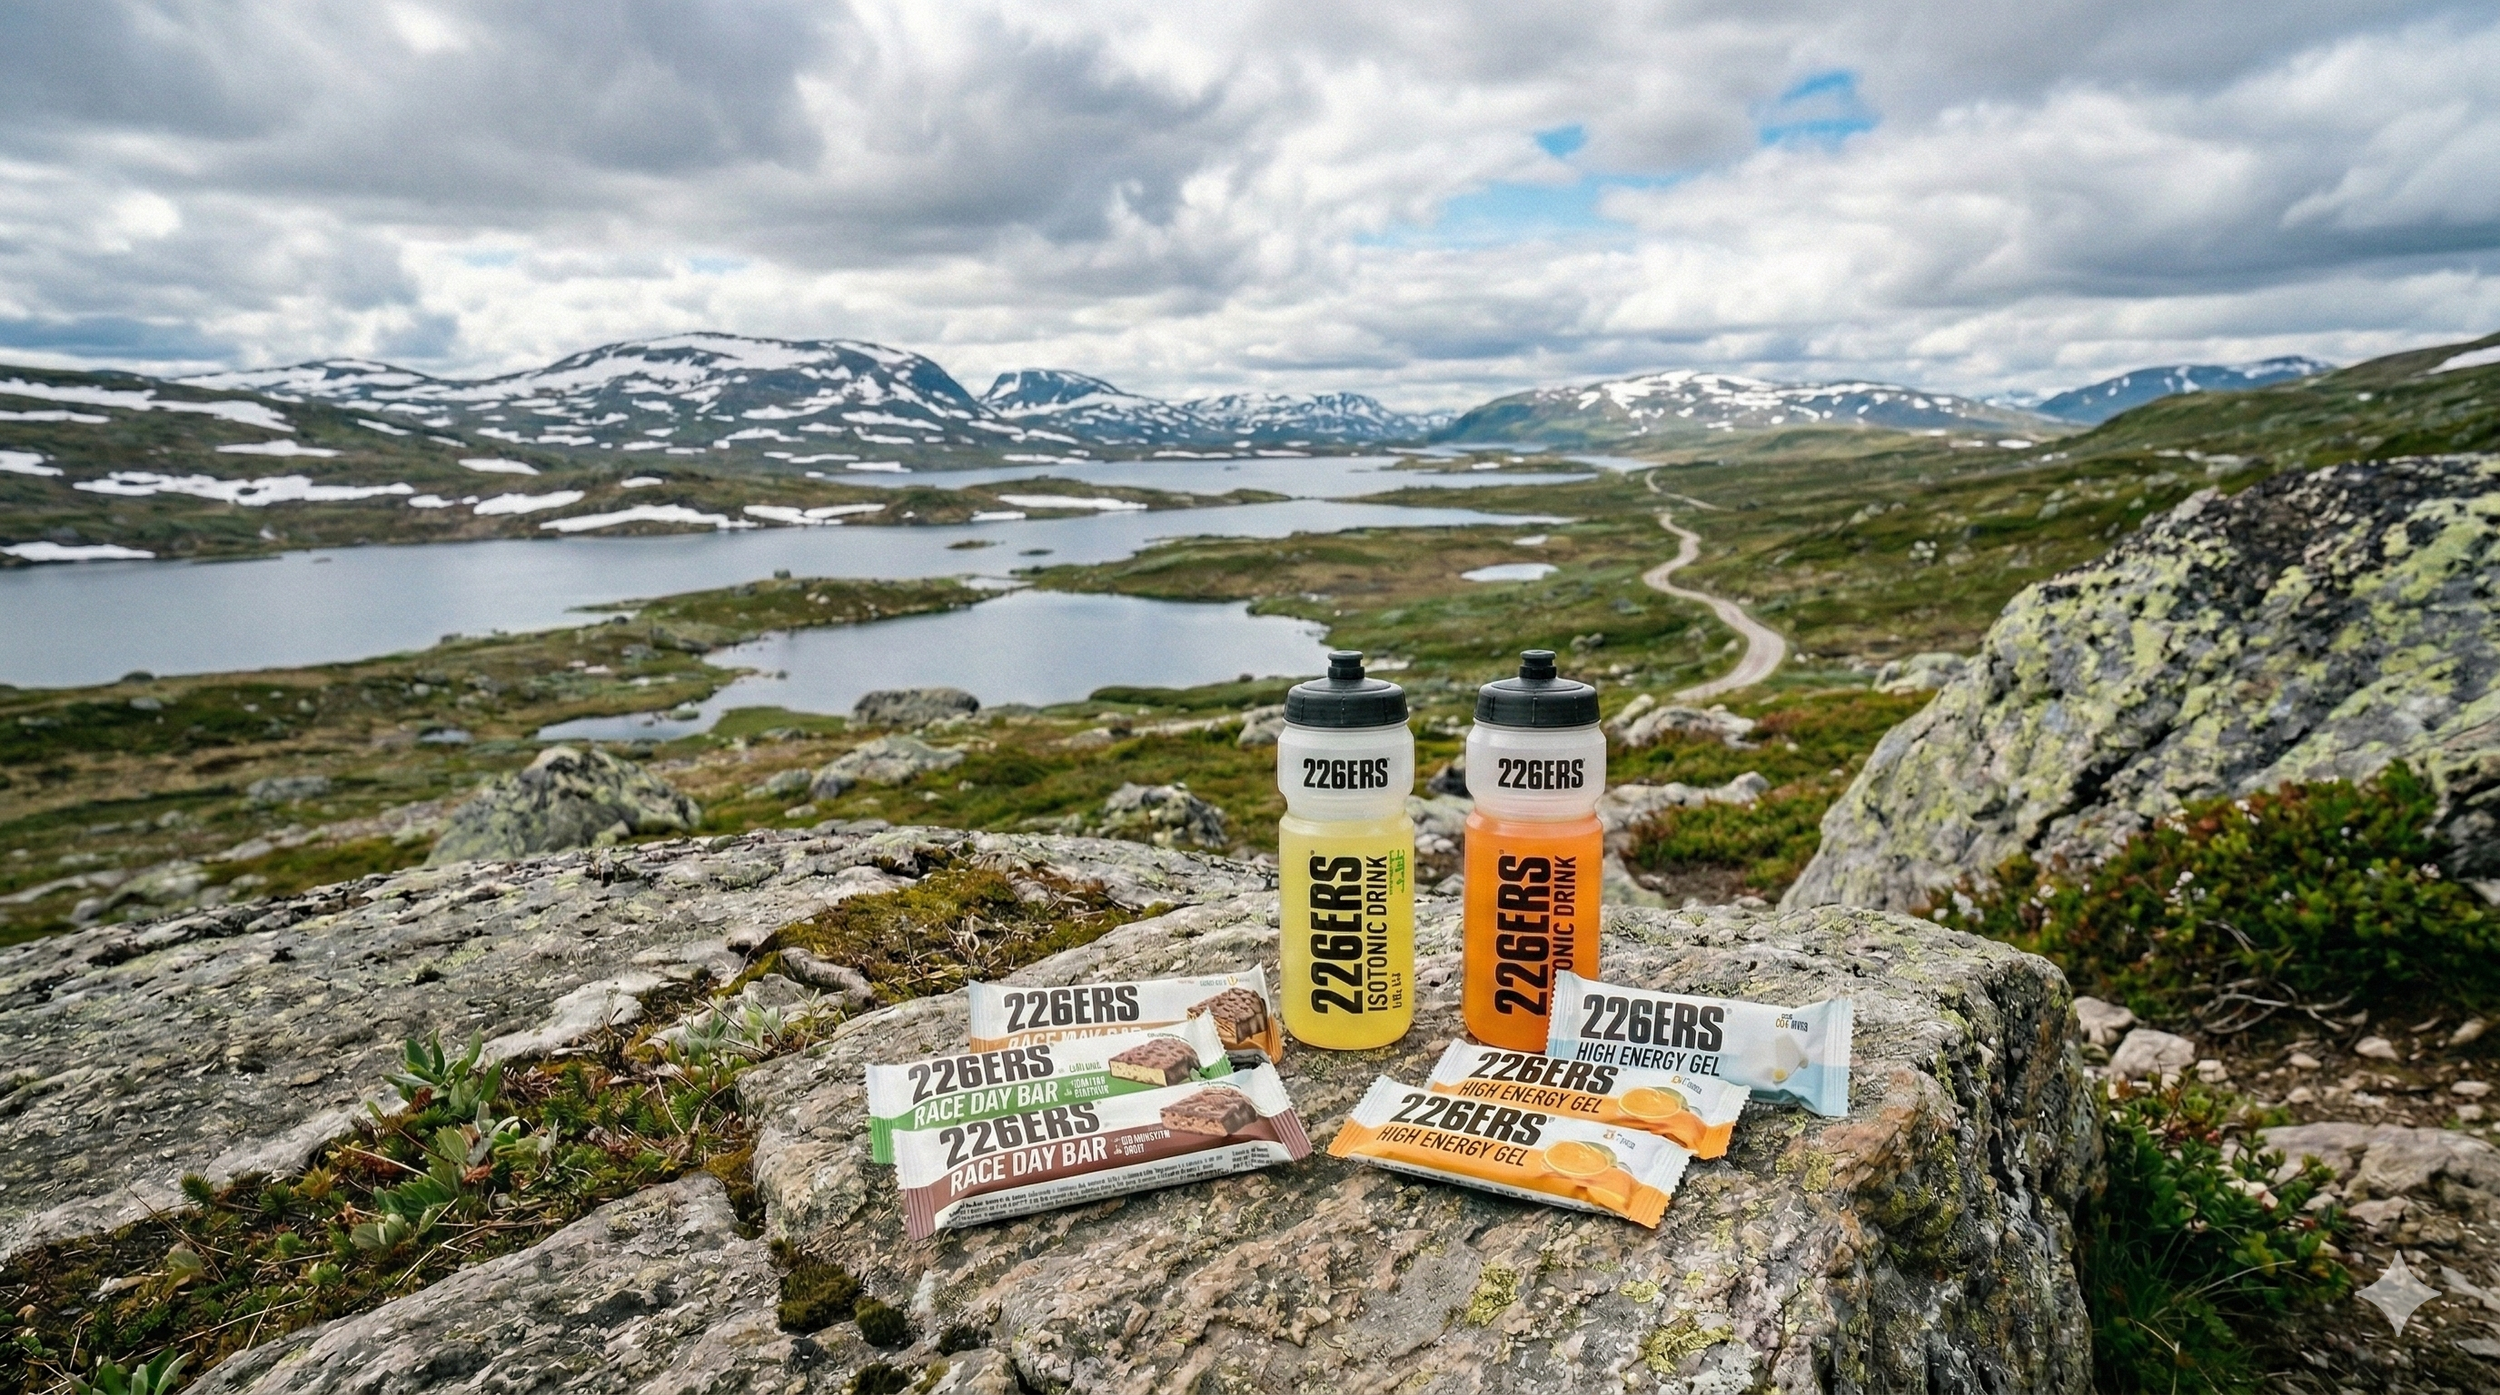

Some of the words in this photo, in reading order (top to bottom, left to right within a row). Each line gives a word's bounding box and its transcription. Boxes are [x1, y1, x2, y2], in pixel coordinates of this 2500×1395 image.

[1303, 758, 1388, 790] 226ERS
[1498, 758, 1584, 790] 226ERS
[1366, 856, 1387, 916] DRINK
[1553, 855, 1576, 916] DRINK
[1310, 856, 1363, 1014] 226ERS
[1495, 855, 1551, 1016] 226ERS
[1366, 921, 1388, 1011] ISOTONIC
[1004, 985, 1140, 1033] 226ERS
[1580, 994, 1724, 1052] 226ERS
[908, 1045, 1054, 1105] 226ERS
[1468, 1052, 1619, 1095] 226ERS
[1576, 1042, 1616, 1063] HIGH
[1619, 1046, 1686, 1071] ENERGY
[1690, 1054, 1720, 1076] GEL
[914, 1095, 966, 1130] RACE
[970, 1087, 1012, 1116] DAY
[1017, 1081, 1058, 1108] BAR
[1389, 1093, 1548, 1146] 226ERS
[1458, 1081, 1500, 1099] HIGH
[1500, 1085, 1570, 1109] ENERGY
[1570, 1096, 1603, 1114] GEL
[939, 1102, 1100, 1170] 226ERS
[1376, 1126, 1423, 1145] HIGH
[1420, 1131, 1496, 1159] ENERGY
[1493, 1147, 1530, 1167] GEL
[950, 1155, 1006, 1198] RACE
[1012, 1146, 1057, 1177] DAY
[1062, 1136, 1108, 1167] BAR
